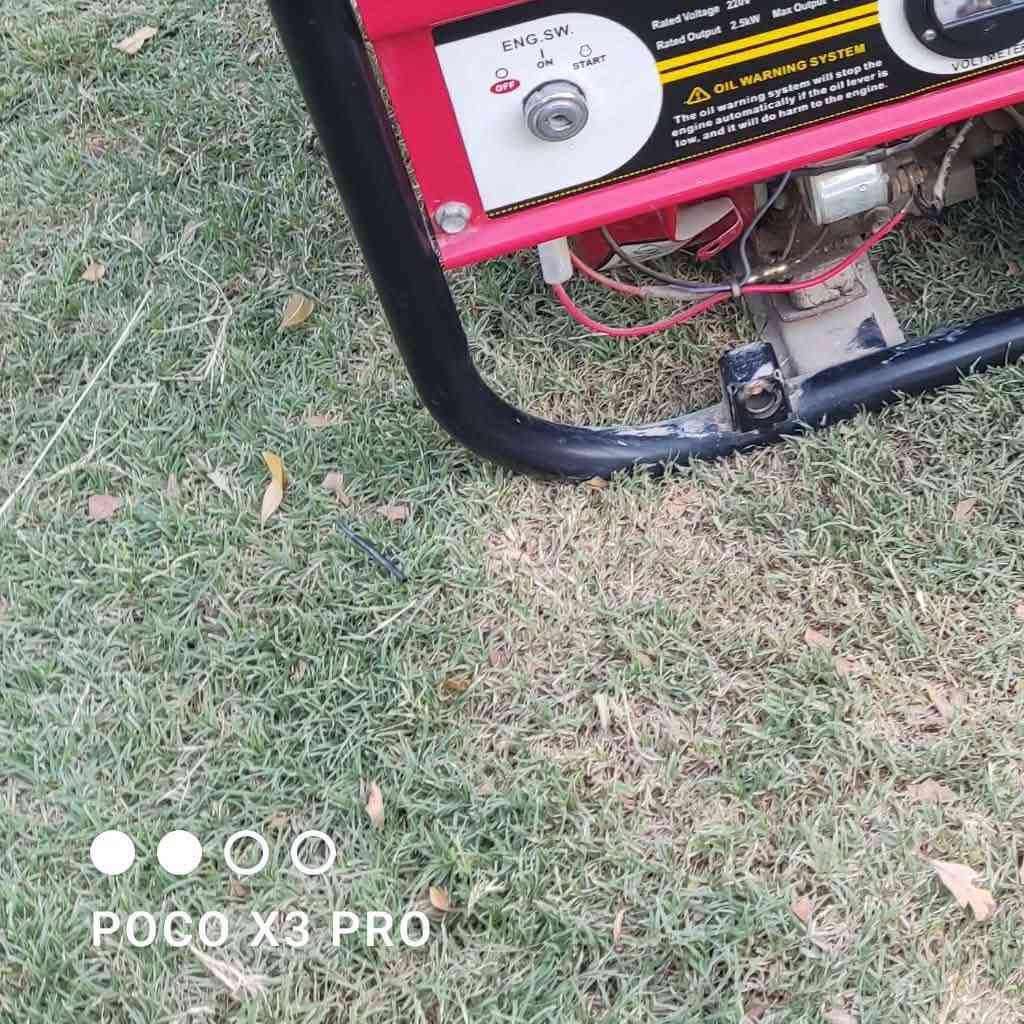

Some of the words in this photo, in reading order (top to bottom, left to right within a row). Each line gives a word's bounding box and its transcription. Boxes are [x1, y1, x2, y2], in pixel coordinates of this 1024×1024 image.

[502, 24, 574, 52] ENG.SW.
[651, 15, 682, 30] Rated
[682, 6, 720, 22] Voltage
[656, 35, 686, 50] Rated
[687, 25, 722, 41] Output
[772, 7, 793, 18] Max
[537, 59, 553, 69] ON
[572, 55, 606, 70] START
[714, 81, 739, 94] OIL
[739, 60, 807, 87] WARNING
[809, 43, 865, 67] SYSTEM
[496, 81, 515, 92] OFF
[672, 119, 713, 137] engine
[715, 95, 796, 125] automatically
[798, 91, 807, 101] if
[808, 87, 827, 98] the
[829, 81, 845, 92] oil
[846, 74, 875, 87] lever
[877, 70, 888, 79] is
[673, 112, 697, 124] The
[699, 105, 715, 117] oil
[717, 93, 765, 112] warning
[768, 80, 810, 98] system
[812, 72, 834, 85] will
[835, 65, 861, 79] stop
[863, 60, 882, 71] the
[675, 136, 700, 148] low,
[702, 127, 725, 140] and
[727, 123, 736, 133] it
[738, 117, 759, 130] will
[761, 113, 776, 123] do
[778, 104, 809, 118] harm
[810, 100, 823, 109] to
[825, 94, 844, 105] the
[845, 82, 888, 99] engine.
